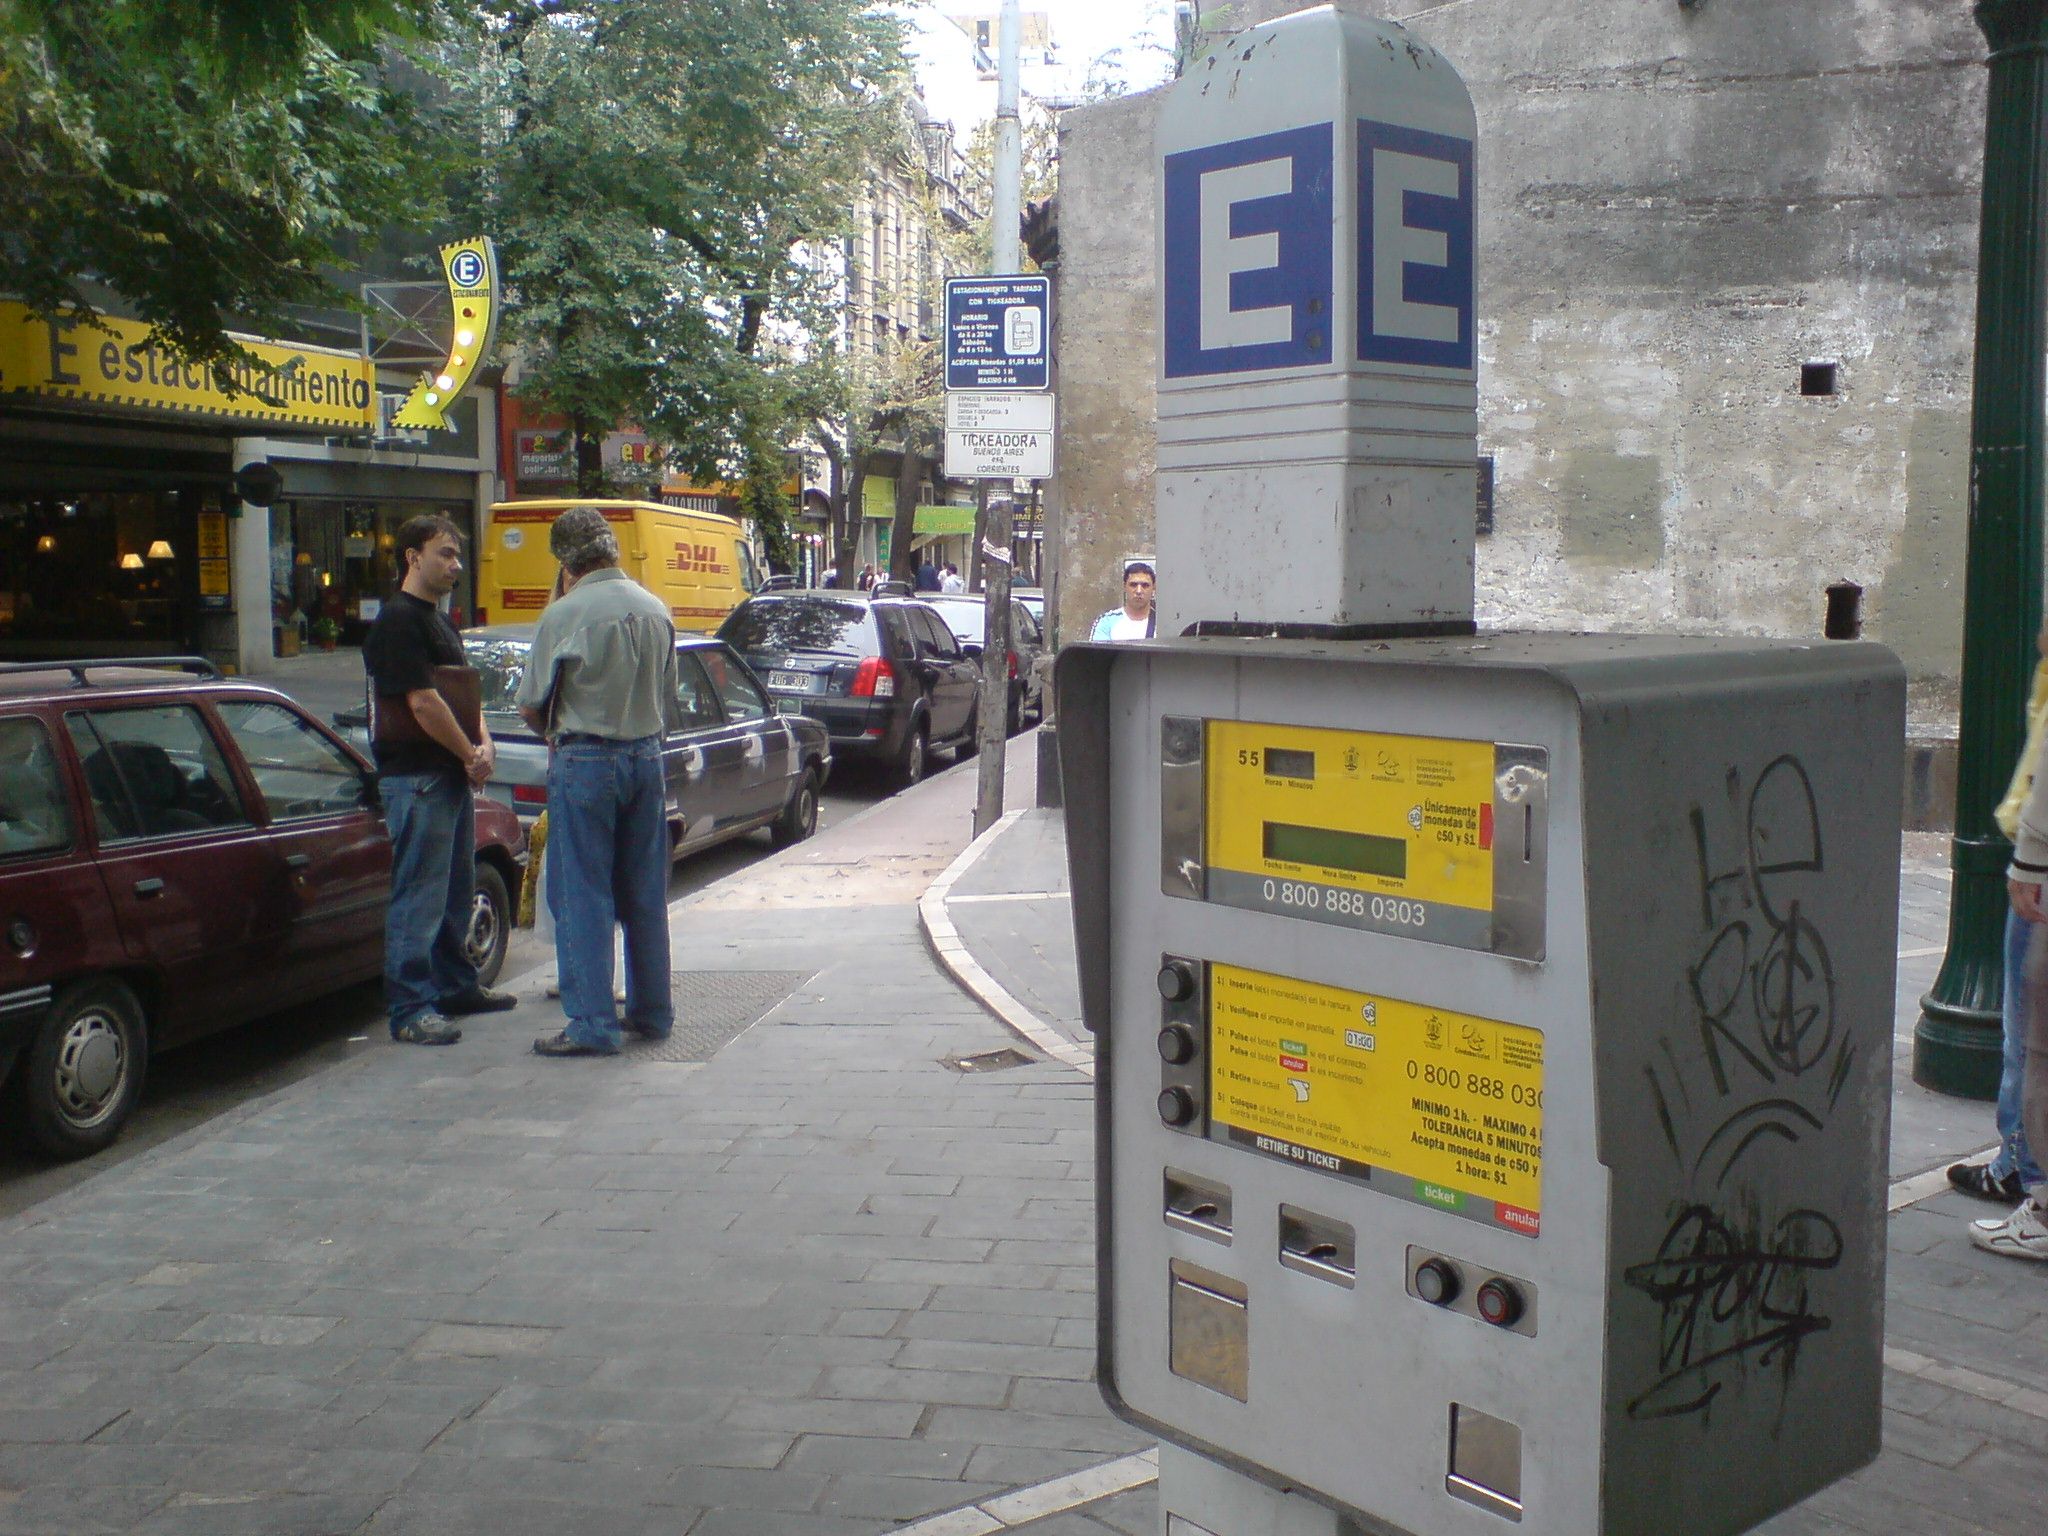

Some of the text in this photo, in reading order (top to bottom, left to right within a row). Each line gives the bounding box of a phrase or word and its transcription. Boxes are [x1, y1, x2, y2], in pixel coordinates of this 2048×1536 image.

[1200, 156, 1292, 350] E
[1373, 148, 1458, 343] E
[460, 257, 474, 280] E
[961, 434, 1037, 447] TICKEADORA
[973, 447, 1024, 456] BUENOS AIRES
[976, 465, 1021, 474] CORRIENTES
[674, 542, 722, 573] DHL
[1264, 779, 1282, 787] Horas
[1424, 798, 1477, 818] Únicamente
[1424, 815, 1477, 830] monedas de
[1455, 834, 1462, 846] y
[1464, 832, 1475, 846] $1
[1322, 868, 1337, 878] Hora
[1377, 878, 1404, 889] Importe
[1263, 879, 1425, 926] 0 800 888 0303
[1407, 1060, 1418, 1079] 0
[1424, 1064, 1460, 1089] 800
[1467, 1074, 1504, 1100] 888
[1412, 1097, 1450, 1118] MINIMO
[1483, 1115, 1526, 1137] MAXIMO
[1530, 1126, 1537, 1139] 4
[1422, 1117, 1483, 1143] TOLERANCIA
[1487, 1133, 1493, 1146] 5
[1496, 1135, 1542, 1159] MINUTOS
[1257, 1136, 1340, 1171] RETIRE SU TICKET
[1411, 1131, 1444, 1150] Acepta
[1447, 1142, 1491, 1163] monedas
[1494, 1153, 1506, 1167] de
[1532, 1165, 1538, 1177] y
[1456, 1160, 1507, 1185] 1 hora: $1
[1424, 1185, 1456, 1204] ticket
[1504, 1209, 1539, 1228] anular
